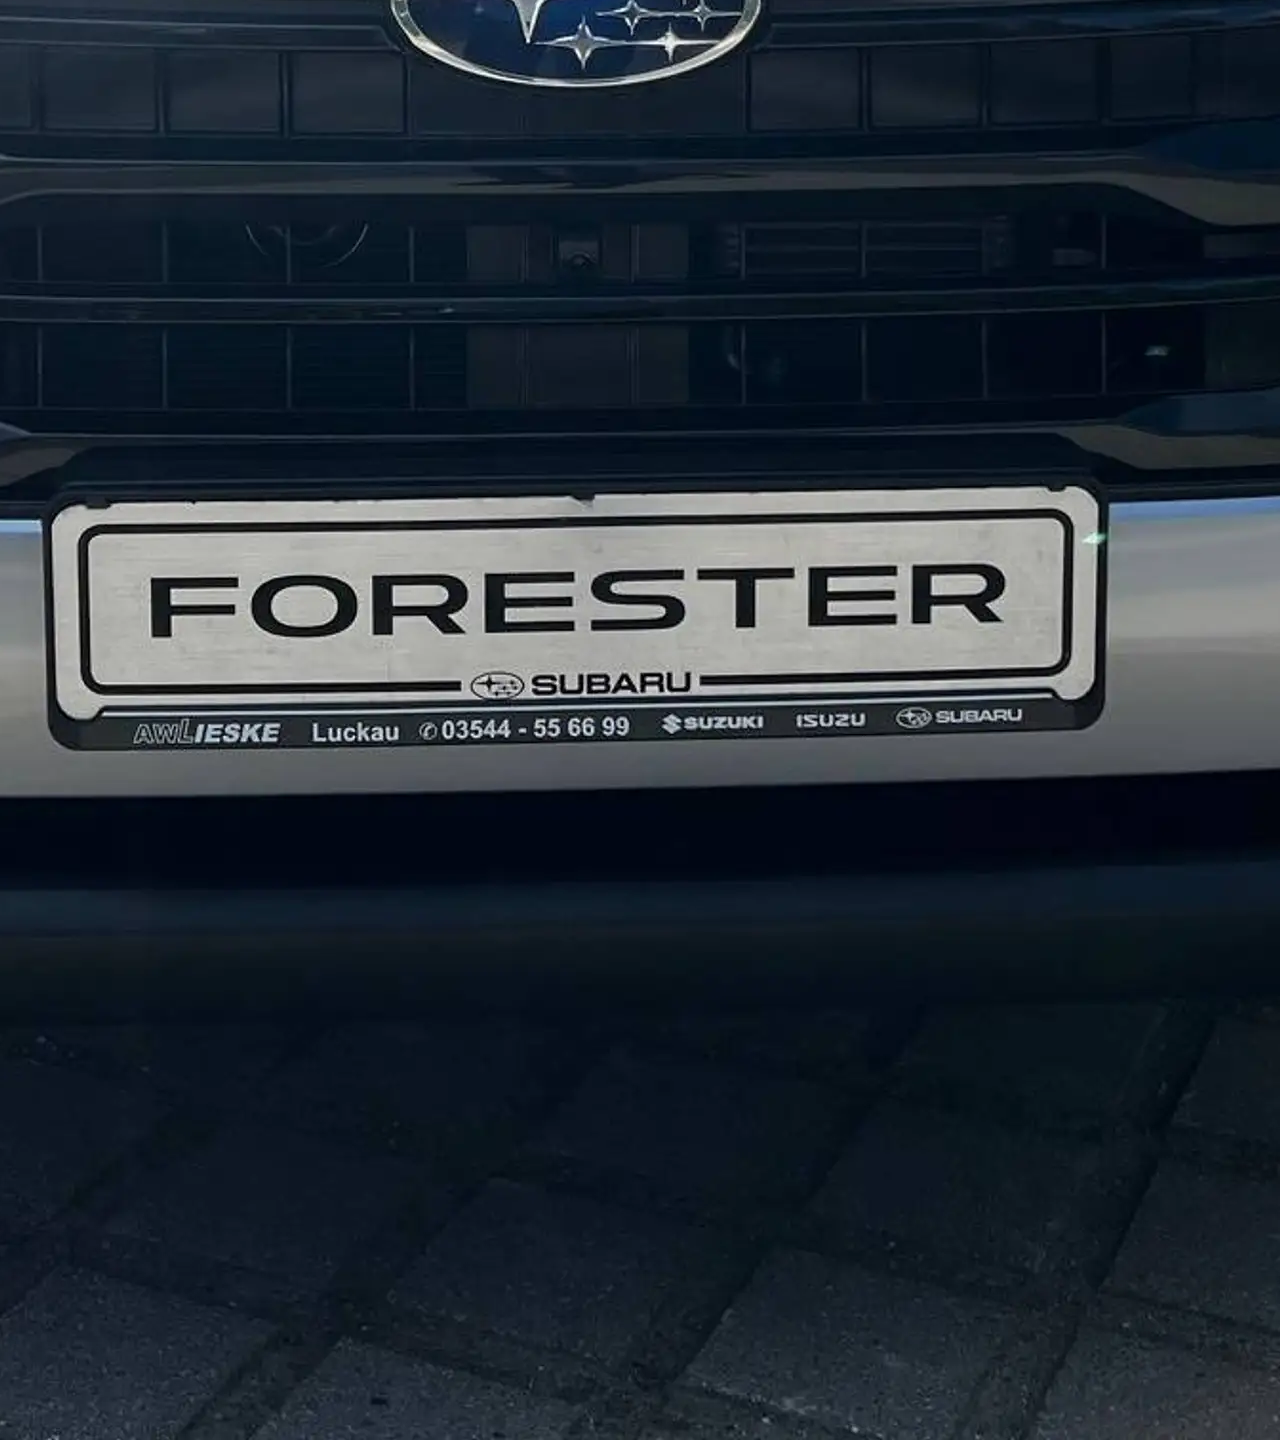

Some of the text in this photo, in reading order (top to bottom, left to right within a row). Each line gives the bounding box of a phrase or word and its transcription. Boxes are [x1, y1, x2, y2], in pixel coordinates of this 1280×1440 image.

[150, 563, 1006, 638] FORESTER
[531, 671, 693, 696] SUBARU
[312, 722, 400, 742] Luckau
[441, 718, 511, 740] 03544
[533, 717, 561, 738] 55
[567, 716, 596, 737] 66
[601, 716, 630, 737] 99
[683, 715, 764, 730] SUZUKI
[796, 712, 866, 728] ISUZU
[935, 708, 1023, 724] SUBARU
